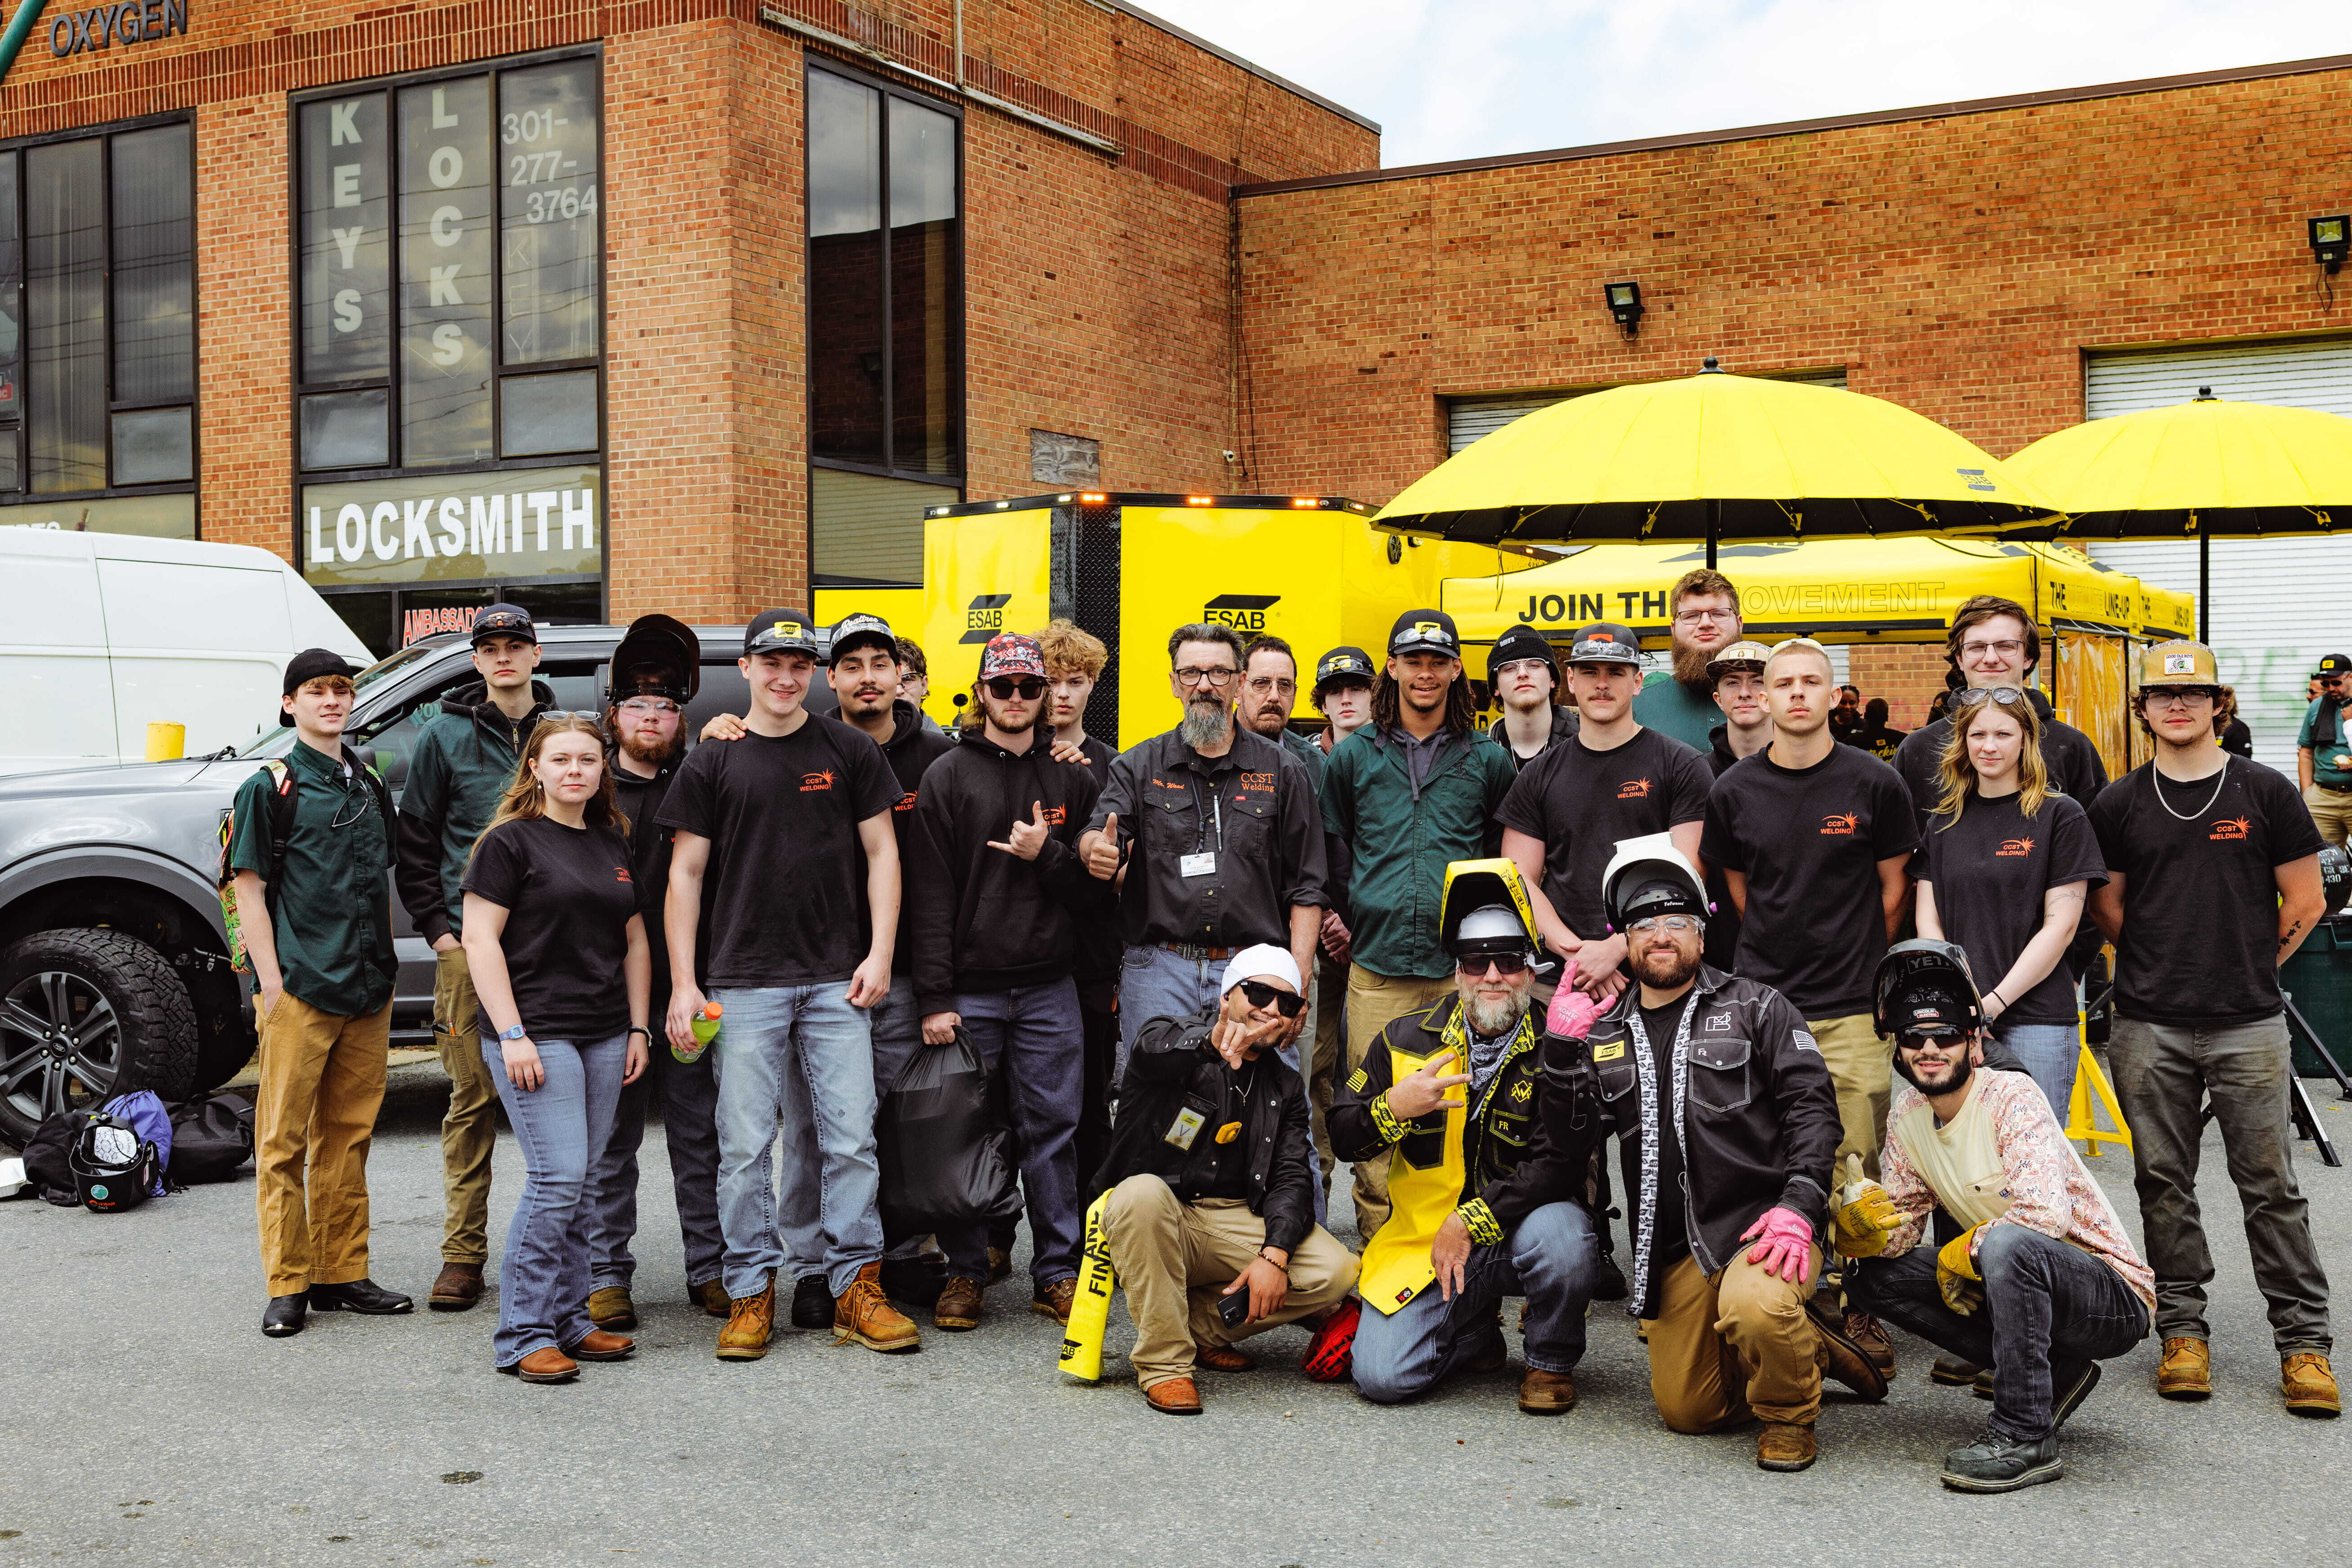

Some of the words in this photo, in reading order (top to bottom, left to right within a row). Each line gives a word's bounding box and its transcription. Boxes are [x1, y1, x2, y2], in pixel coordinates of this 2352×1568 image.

[50, 0, 187, 57] OXYGEN
[502, 108, 569, 144] 301-
[511, 150, 577, 187] 277-
[331, 101, 364, 333] KEYS
[526, 185, 597, 224] 3764
[428, 89, 463, 366] LOCKS
[310, 488, 594, 563] LOCKSMITH
[1519, 593, 1603, 622] JOIN
[1617, 590, 1673, 618] TH
[1738, 582, 1945, 615] OVEMENT
[2050, 581, 2068, 611] THE
[968, 610, 1002, 629] ESAB
[1204, 610, 1265, 630] ESAB
[1241, 773, 1274, 784] CCST
[1241, 783, 1274, 793] Welding
[1501, 869, 1523, 911] REBEL
[1557, 1006, 1578, 1020] DEMON
[1558, 1012, 1571, 1023] BLUE
[1499, 1120, 1509, 1131] FR
[1792, 1223, 1804, 1235] BLUE
